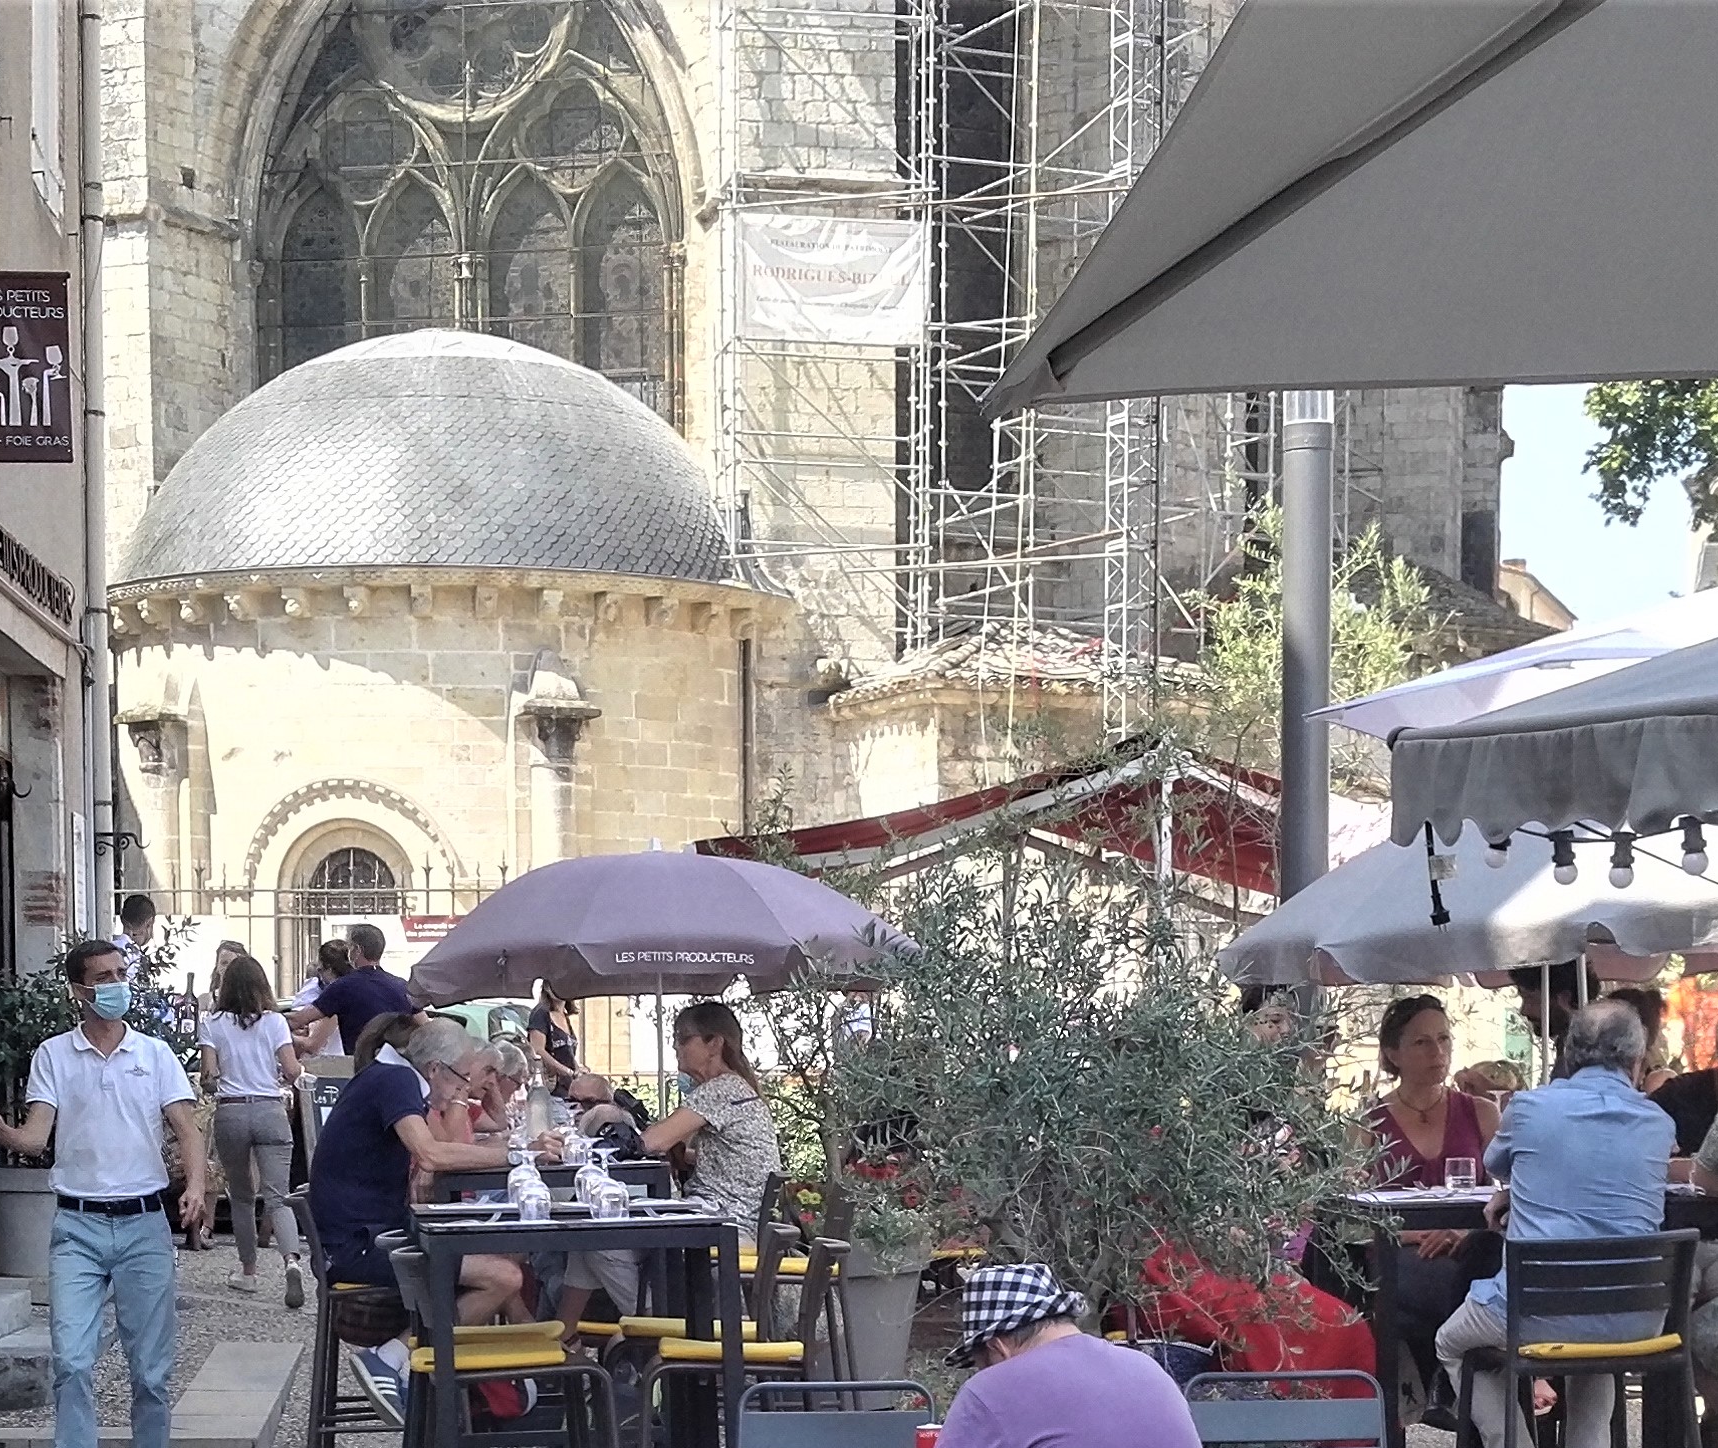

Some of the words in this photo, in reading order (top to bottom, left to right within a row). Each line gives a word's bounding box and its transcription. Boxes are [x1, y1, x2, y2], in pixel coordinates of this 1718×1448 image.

[6, 289, 51, 302] PETITS
[6, 435, 32, 446] FOIE
[35, 435, 70, 446] GRAS
[615, 952, 635, 963] LES
[637, 951, 674, 963] PETITS
[675, 952, 755, 965] PRODUCTEURS
